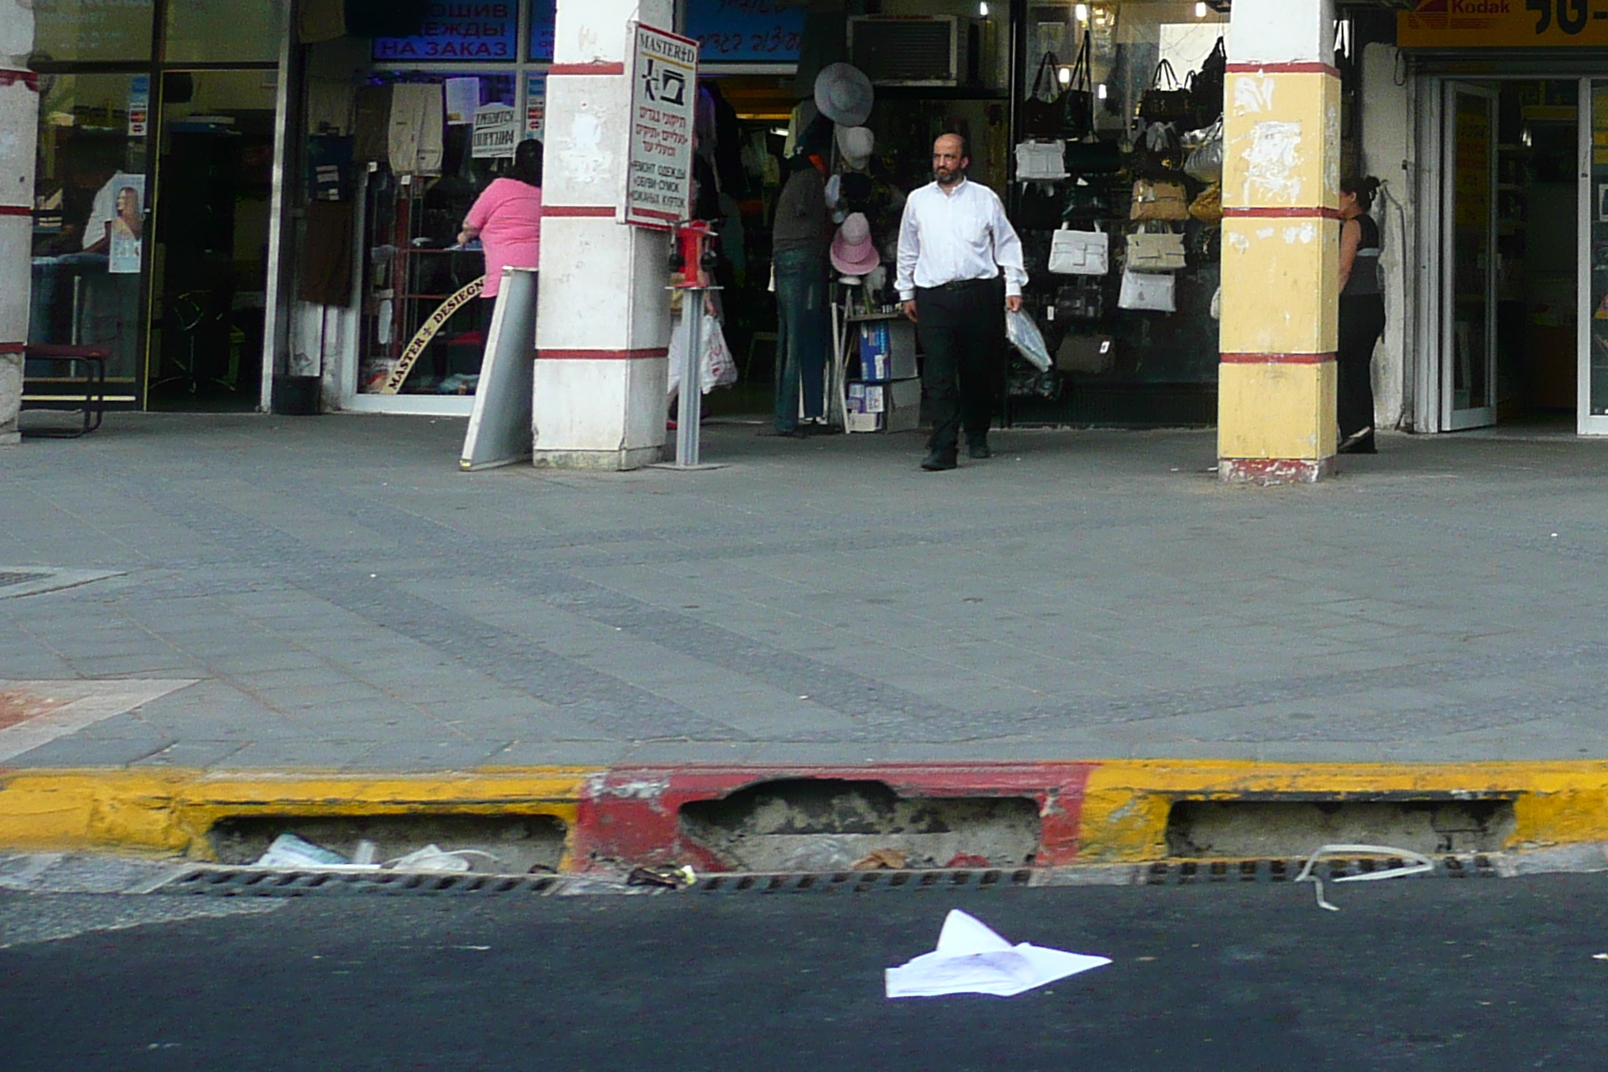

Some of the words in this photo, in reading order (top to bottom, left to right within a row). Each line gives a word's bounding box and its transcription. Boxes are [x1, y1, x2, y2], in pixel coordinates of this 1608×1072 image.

[430, 2, 509, 19] ОШИВ
[381, 41, 416, 57] НА
[425, 41, 508, 57] ЗАКАЗ
[639, 33, 681, 60] MASTER
[388, 337, 426, 390] MASTER
